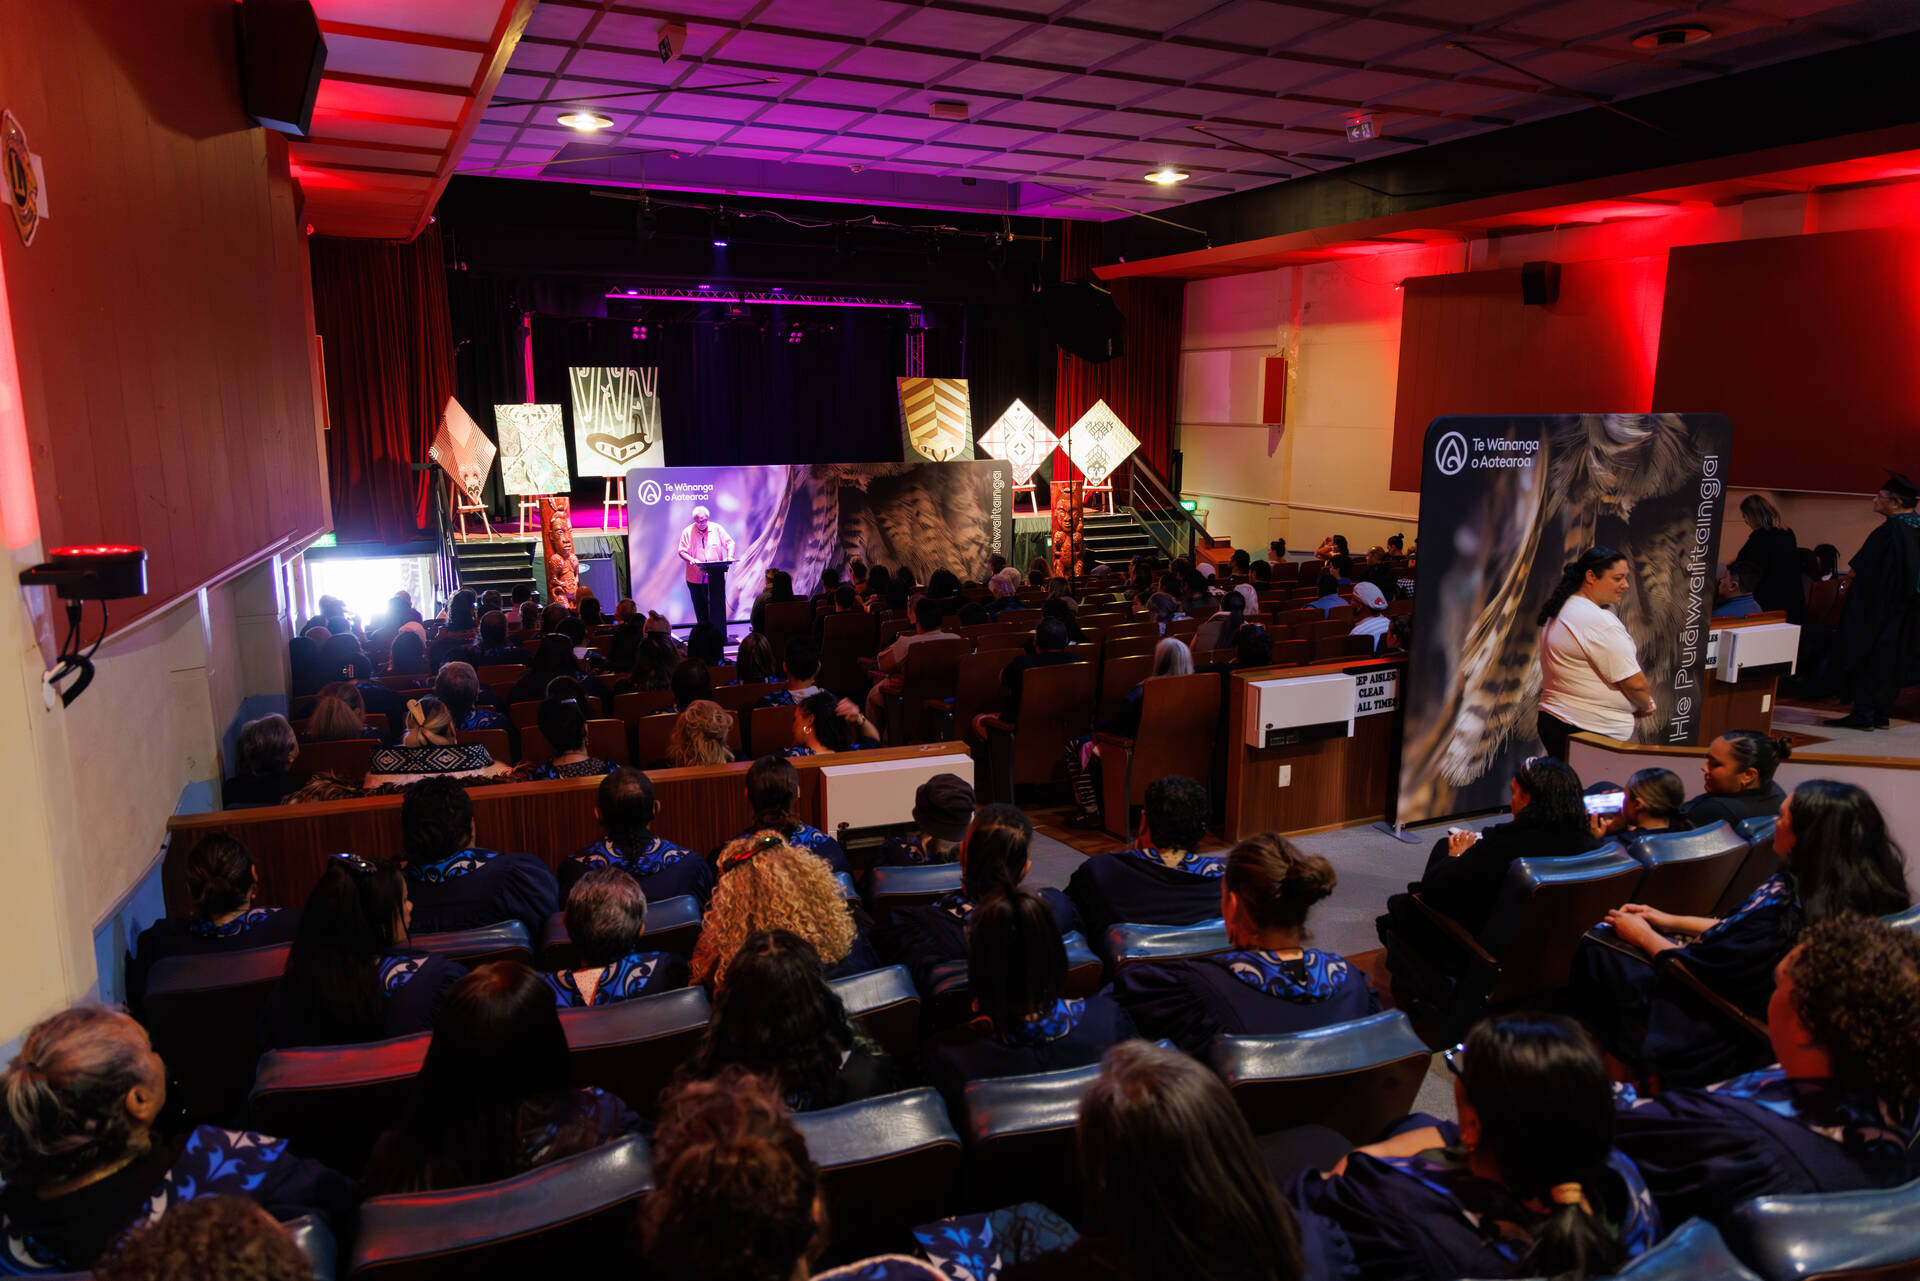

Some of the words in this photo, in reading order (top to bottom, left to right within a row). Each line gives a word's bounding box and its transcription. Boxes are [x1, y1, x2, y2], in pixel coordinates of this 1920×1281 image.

[1472, 438, 1485, 451] Te
[1487, 438, 1539, 454] Wānanga
[1471, 458, 1479, 468] o
[1480, 455, 1531, 468] Aotearoa
[663, 483, 673, 492] Te
[674, 482, 713, 493] Wānanga
[671, 493, 709, 501] Aotearoa
[990, 470, 1005, 554] āwaitanga
[1674, 455, 1721, 690] Puāwaitanga
[1369, 671, 1397, 684] AISLES
[1359, 686, 1384, 698] CLEAR
[1357, 701, 1372, 712] ALL
[1374, 697, 1398, 709] TIMES
[1669, 696, 1692, 742] He
